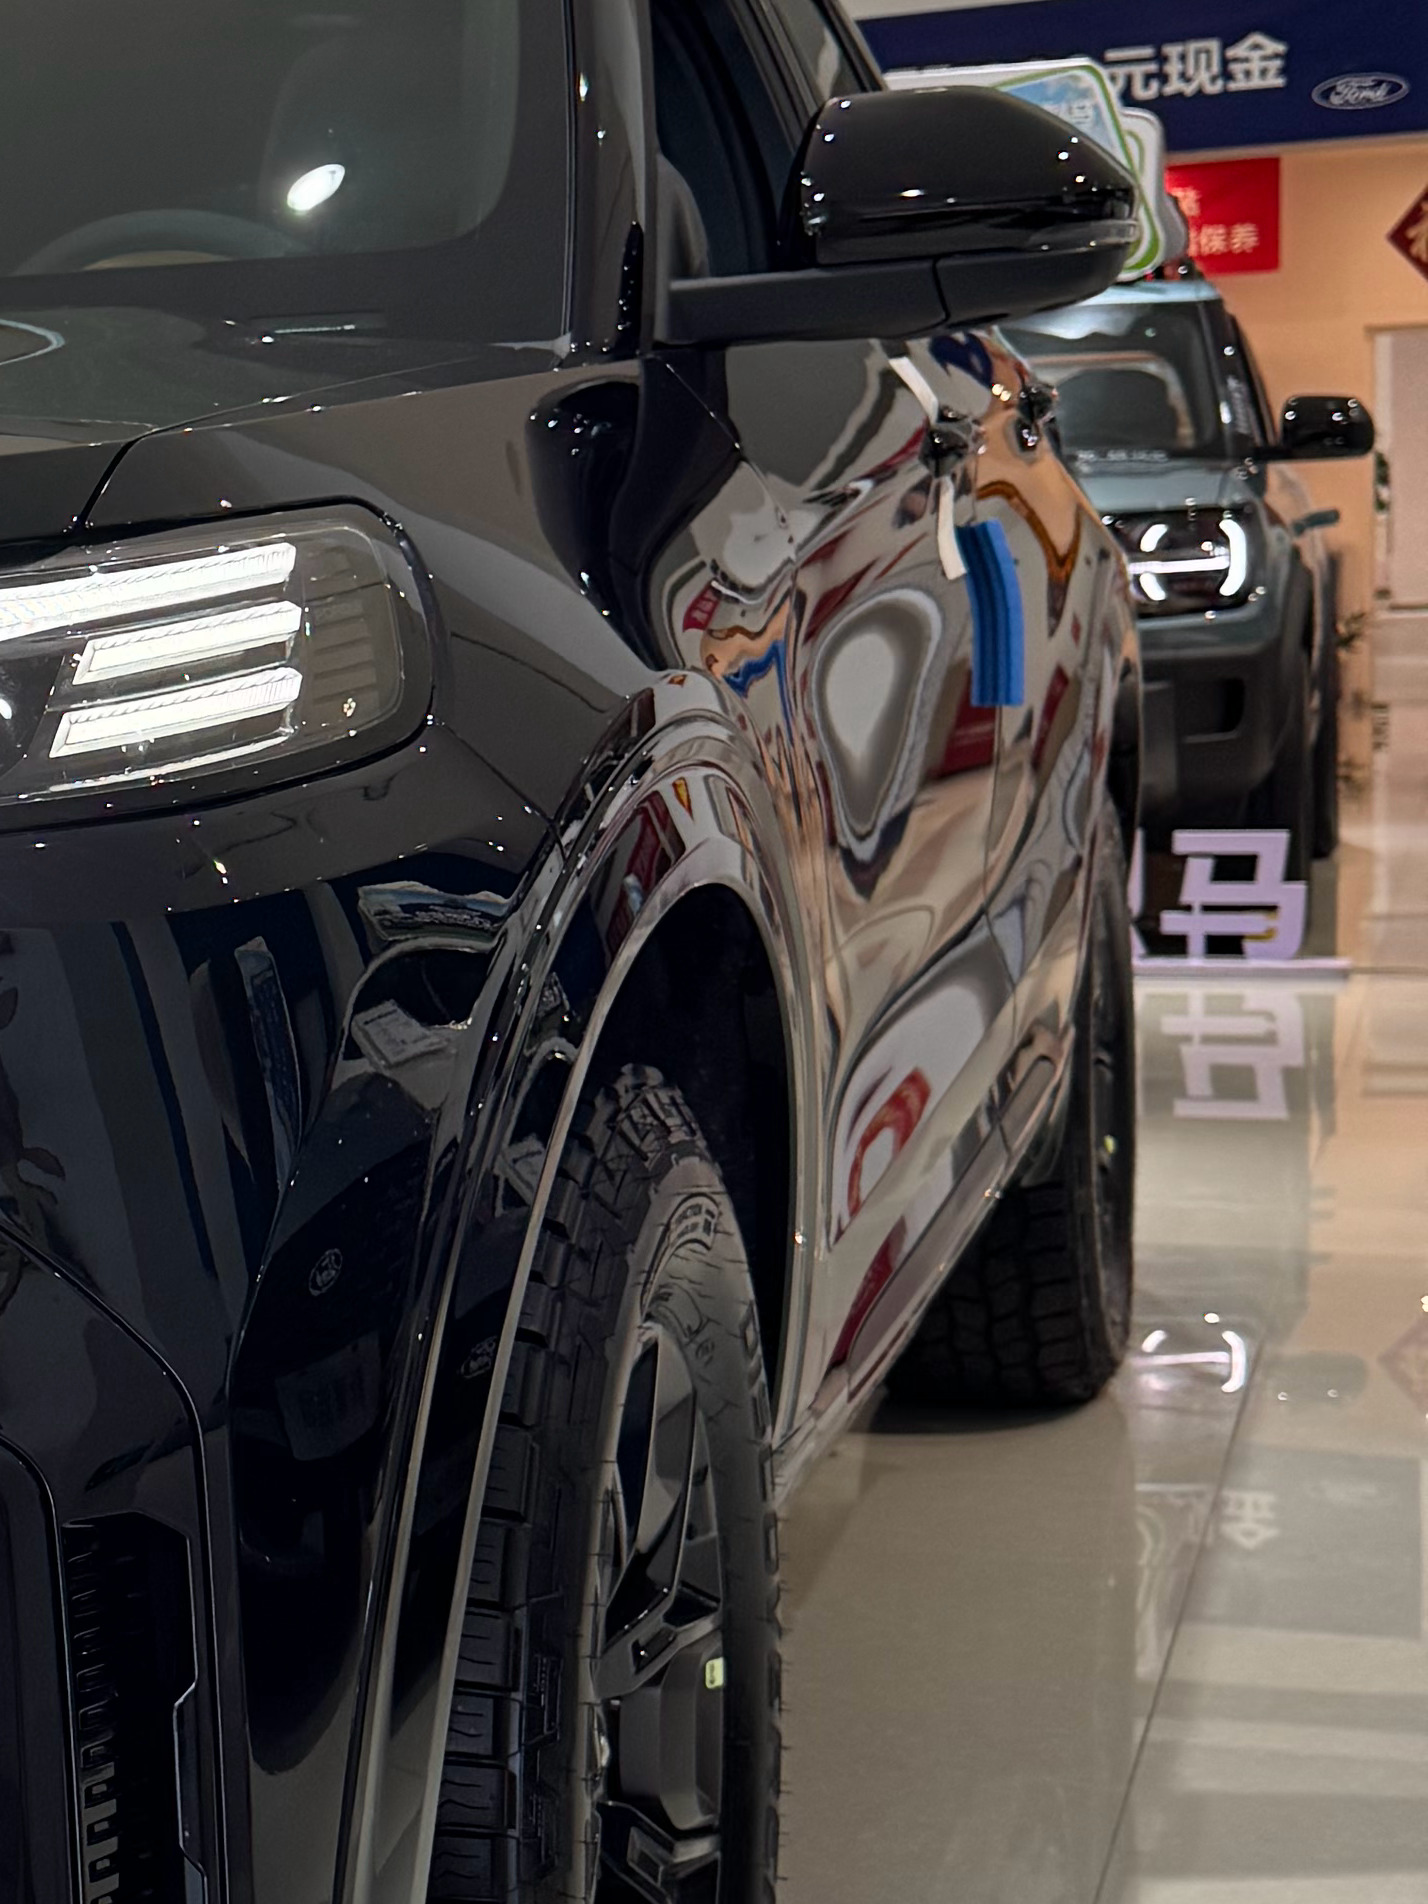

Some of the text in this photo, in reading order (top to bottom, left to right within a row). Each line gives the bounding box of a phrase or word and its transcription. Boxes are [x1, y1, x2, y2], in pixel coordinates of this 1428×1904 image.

[1104, 31, 1287, 101] 元现金
[1330, 76, 1392, 106] Ford
[1189, 223, 1260, 258] 保养
[1130, 829, 1307, 961] 马
